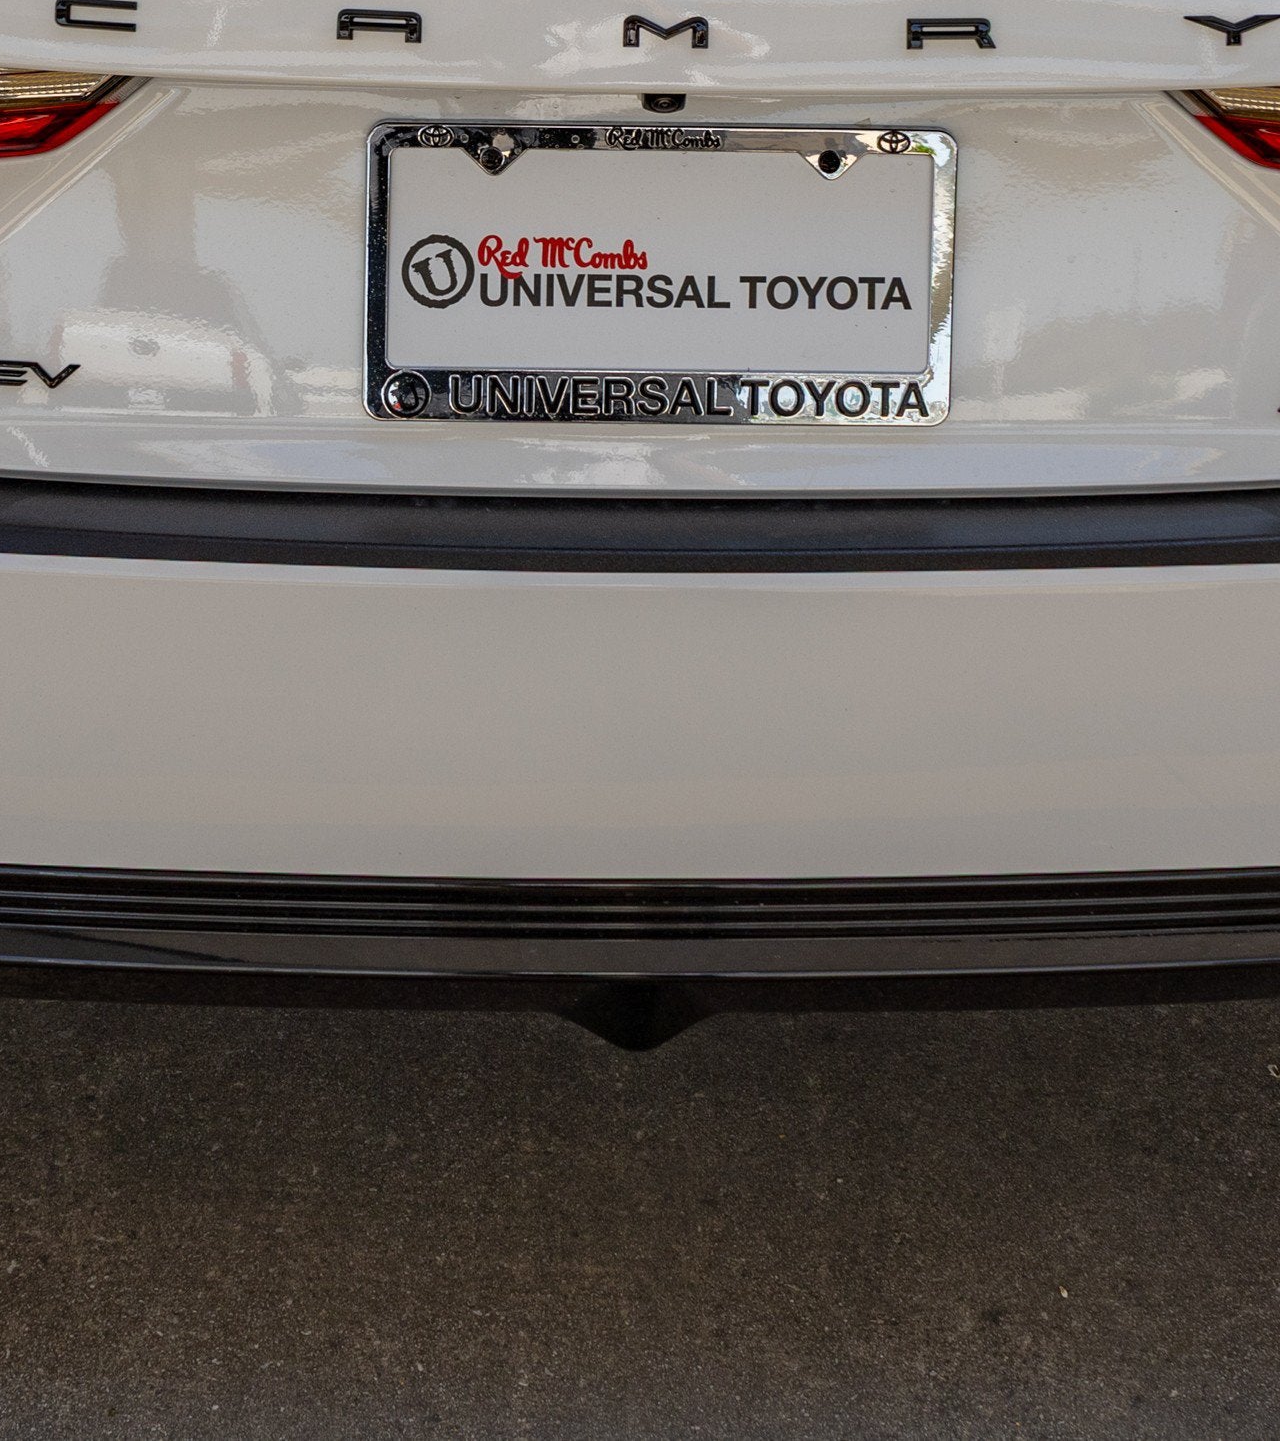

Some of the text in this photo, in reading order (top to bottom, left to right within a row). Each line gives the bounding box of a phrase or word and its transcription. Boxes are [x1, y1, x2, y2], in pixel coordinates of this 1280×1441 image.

[605, 127, 721, 150] Red McCombs
[478, 234, 648, 279] Red McCombs
[480, 273, 913, 310] UNIVERSAL TOYOTA
[448, 374, 930, 419] UNIVERSAL TOYOTA
